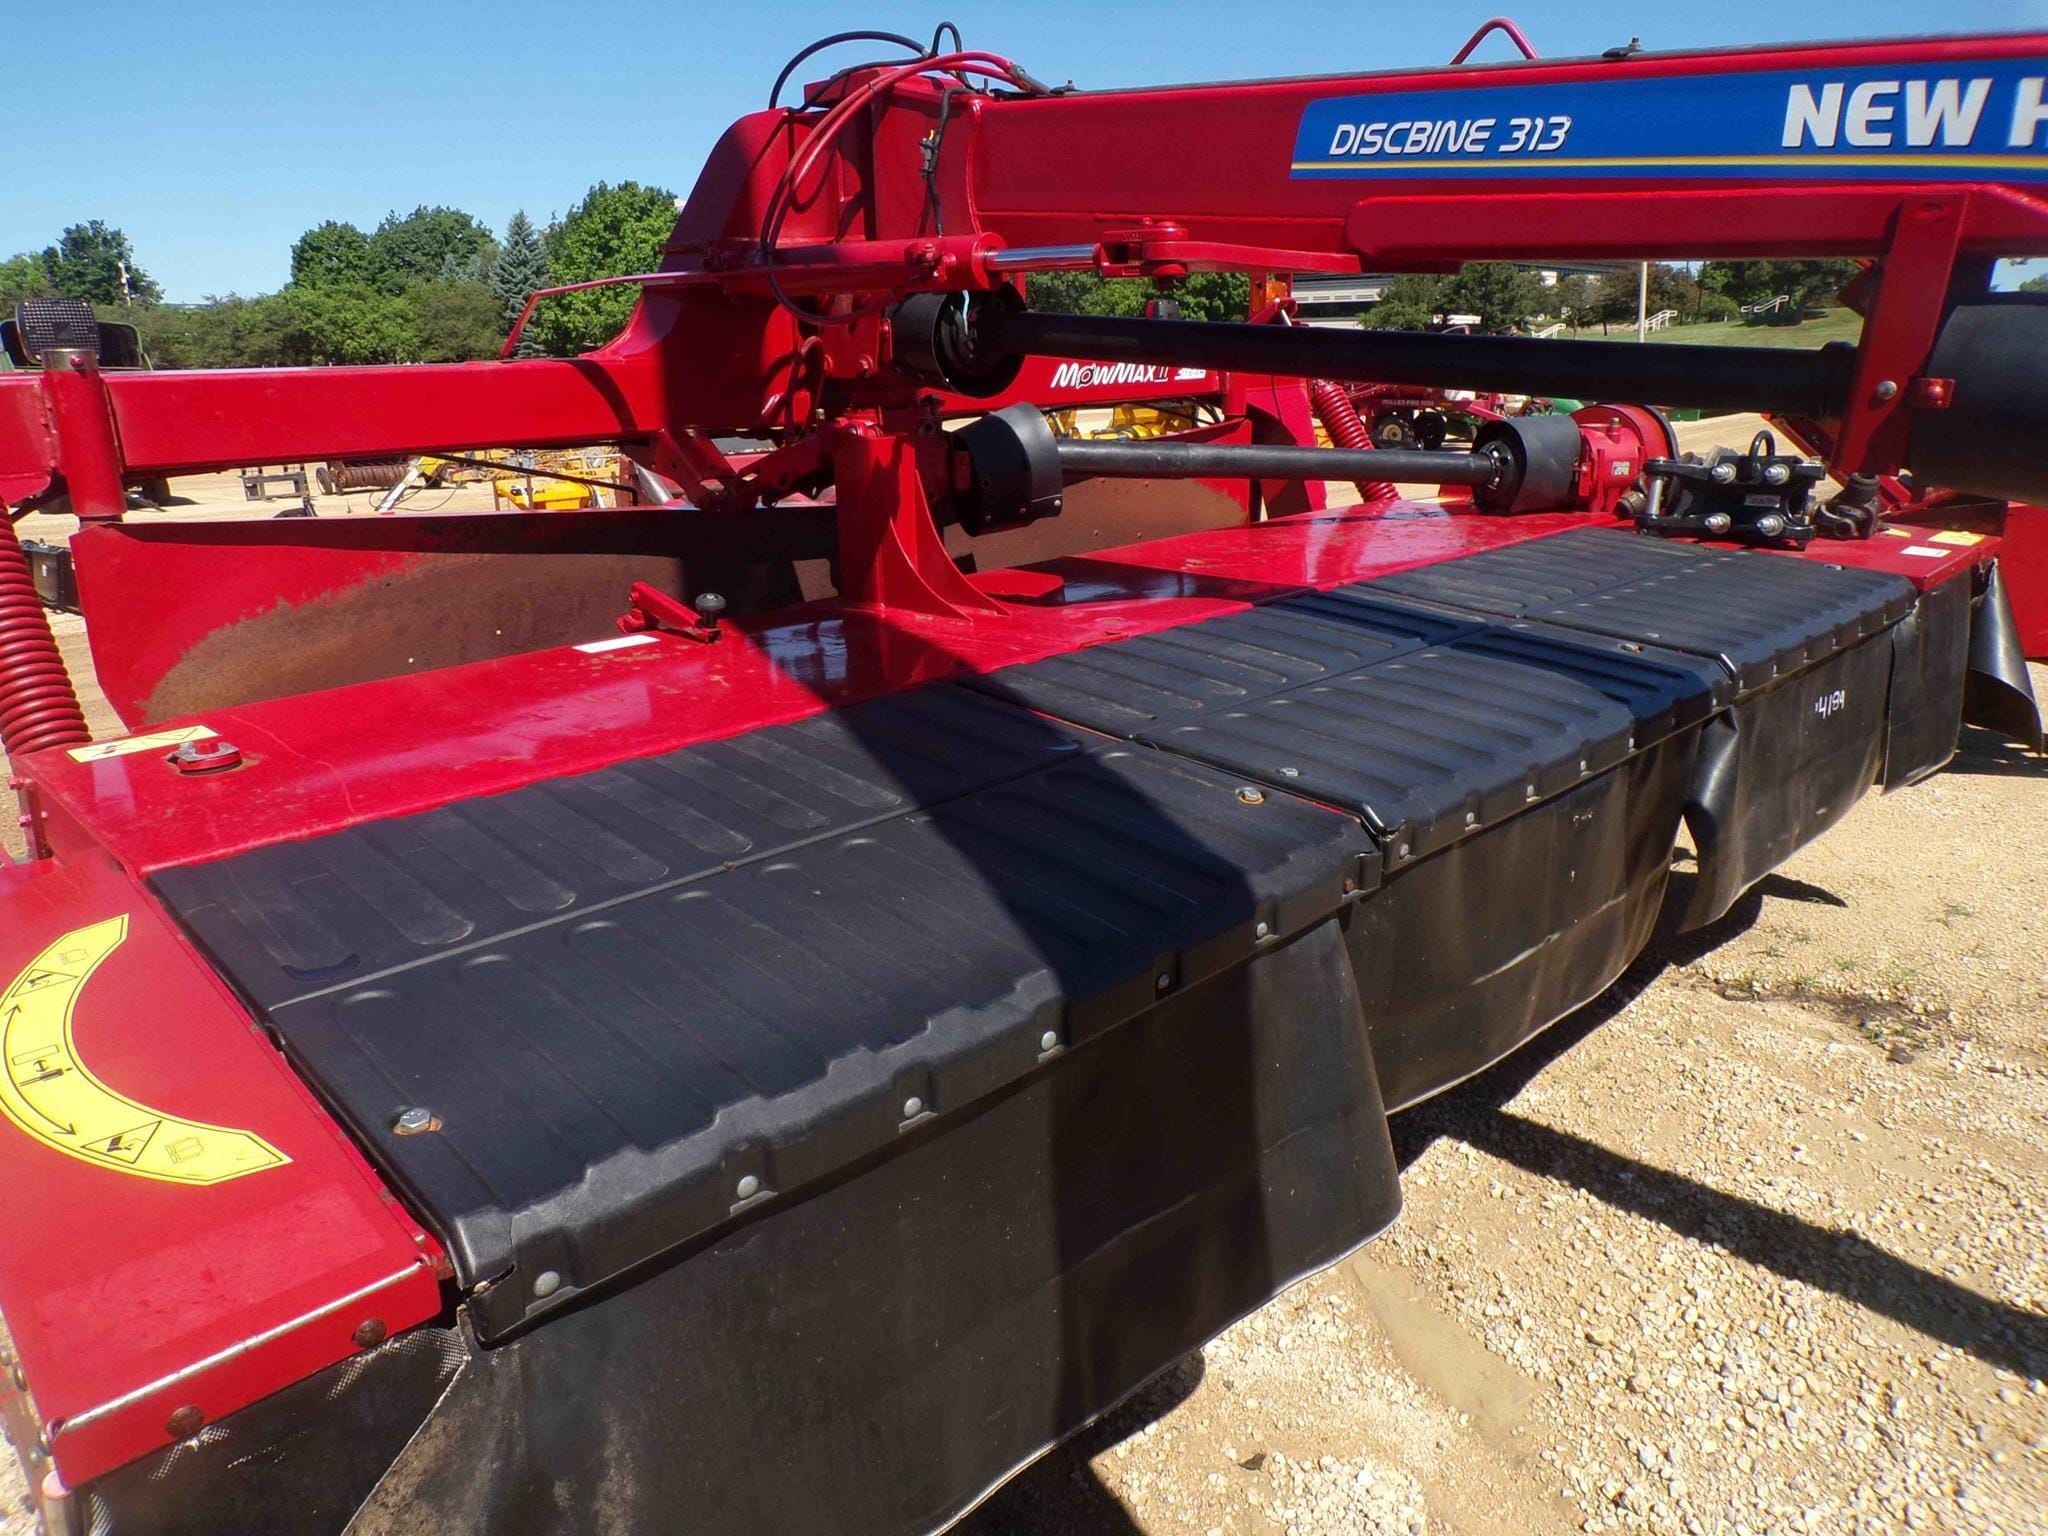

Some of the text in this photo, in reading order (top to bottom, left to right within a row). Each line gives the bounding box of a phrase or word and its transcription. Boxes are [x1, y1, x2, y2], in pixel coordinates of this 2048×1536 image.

[1329, 115, 1573, 156] DISCBINE 313
[1781, 77, 1994, 147] NEW
